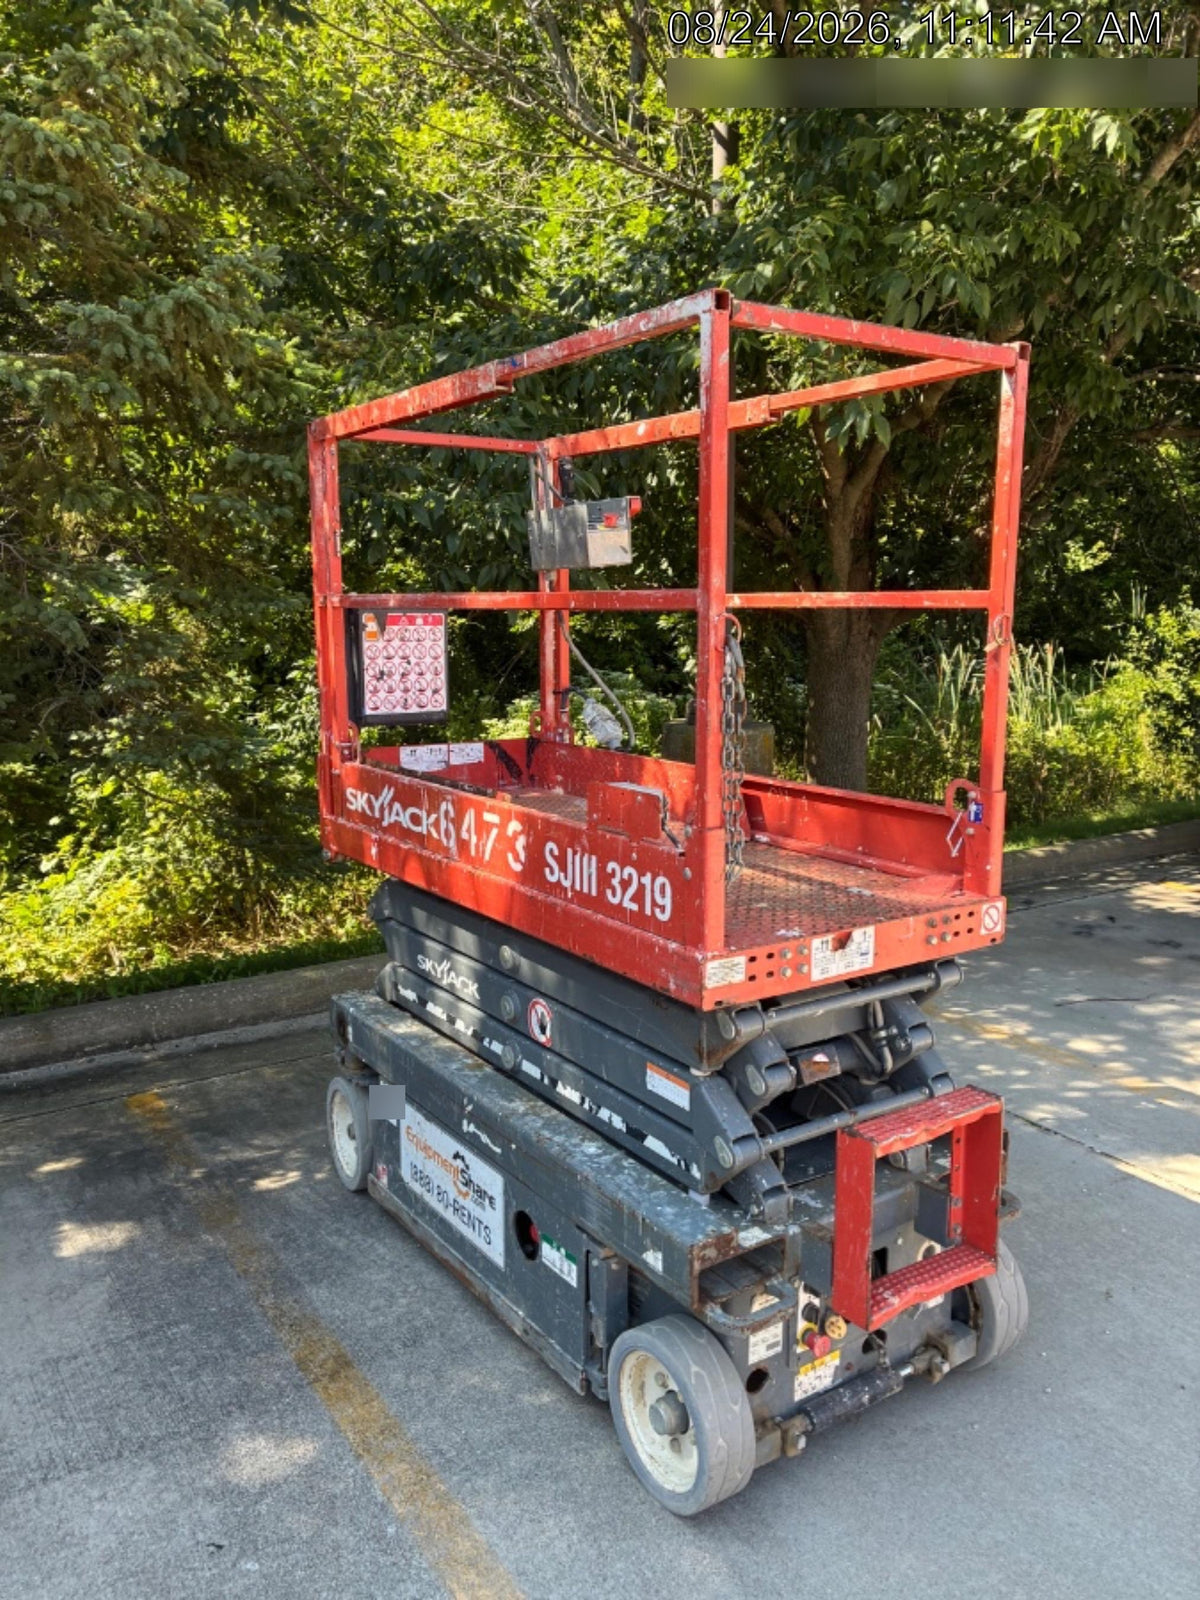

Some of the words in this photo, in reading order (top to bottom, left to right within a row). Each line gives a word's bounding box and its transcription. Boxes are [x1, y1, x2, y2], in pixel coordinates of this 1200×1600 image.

[345, 784, 440, 840] SKYJACK
[605, 861, 673, 922] 3219
[417, 954, 480, 1000] SKYJACK
[405, 1125, 497, 1211] EquipmentShare
